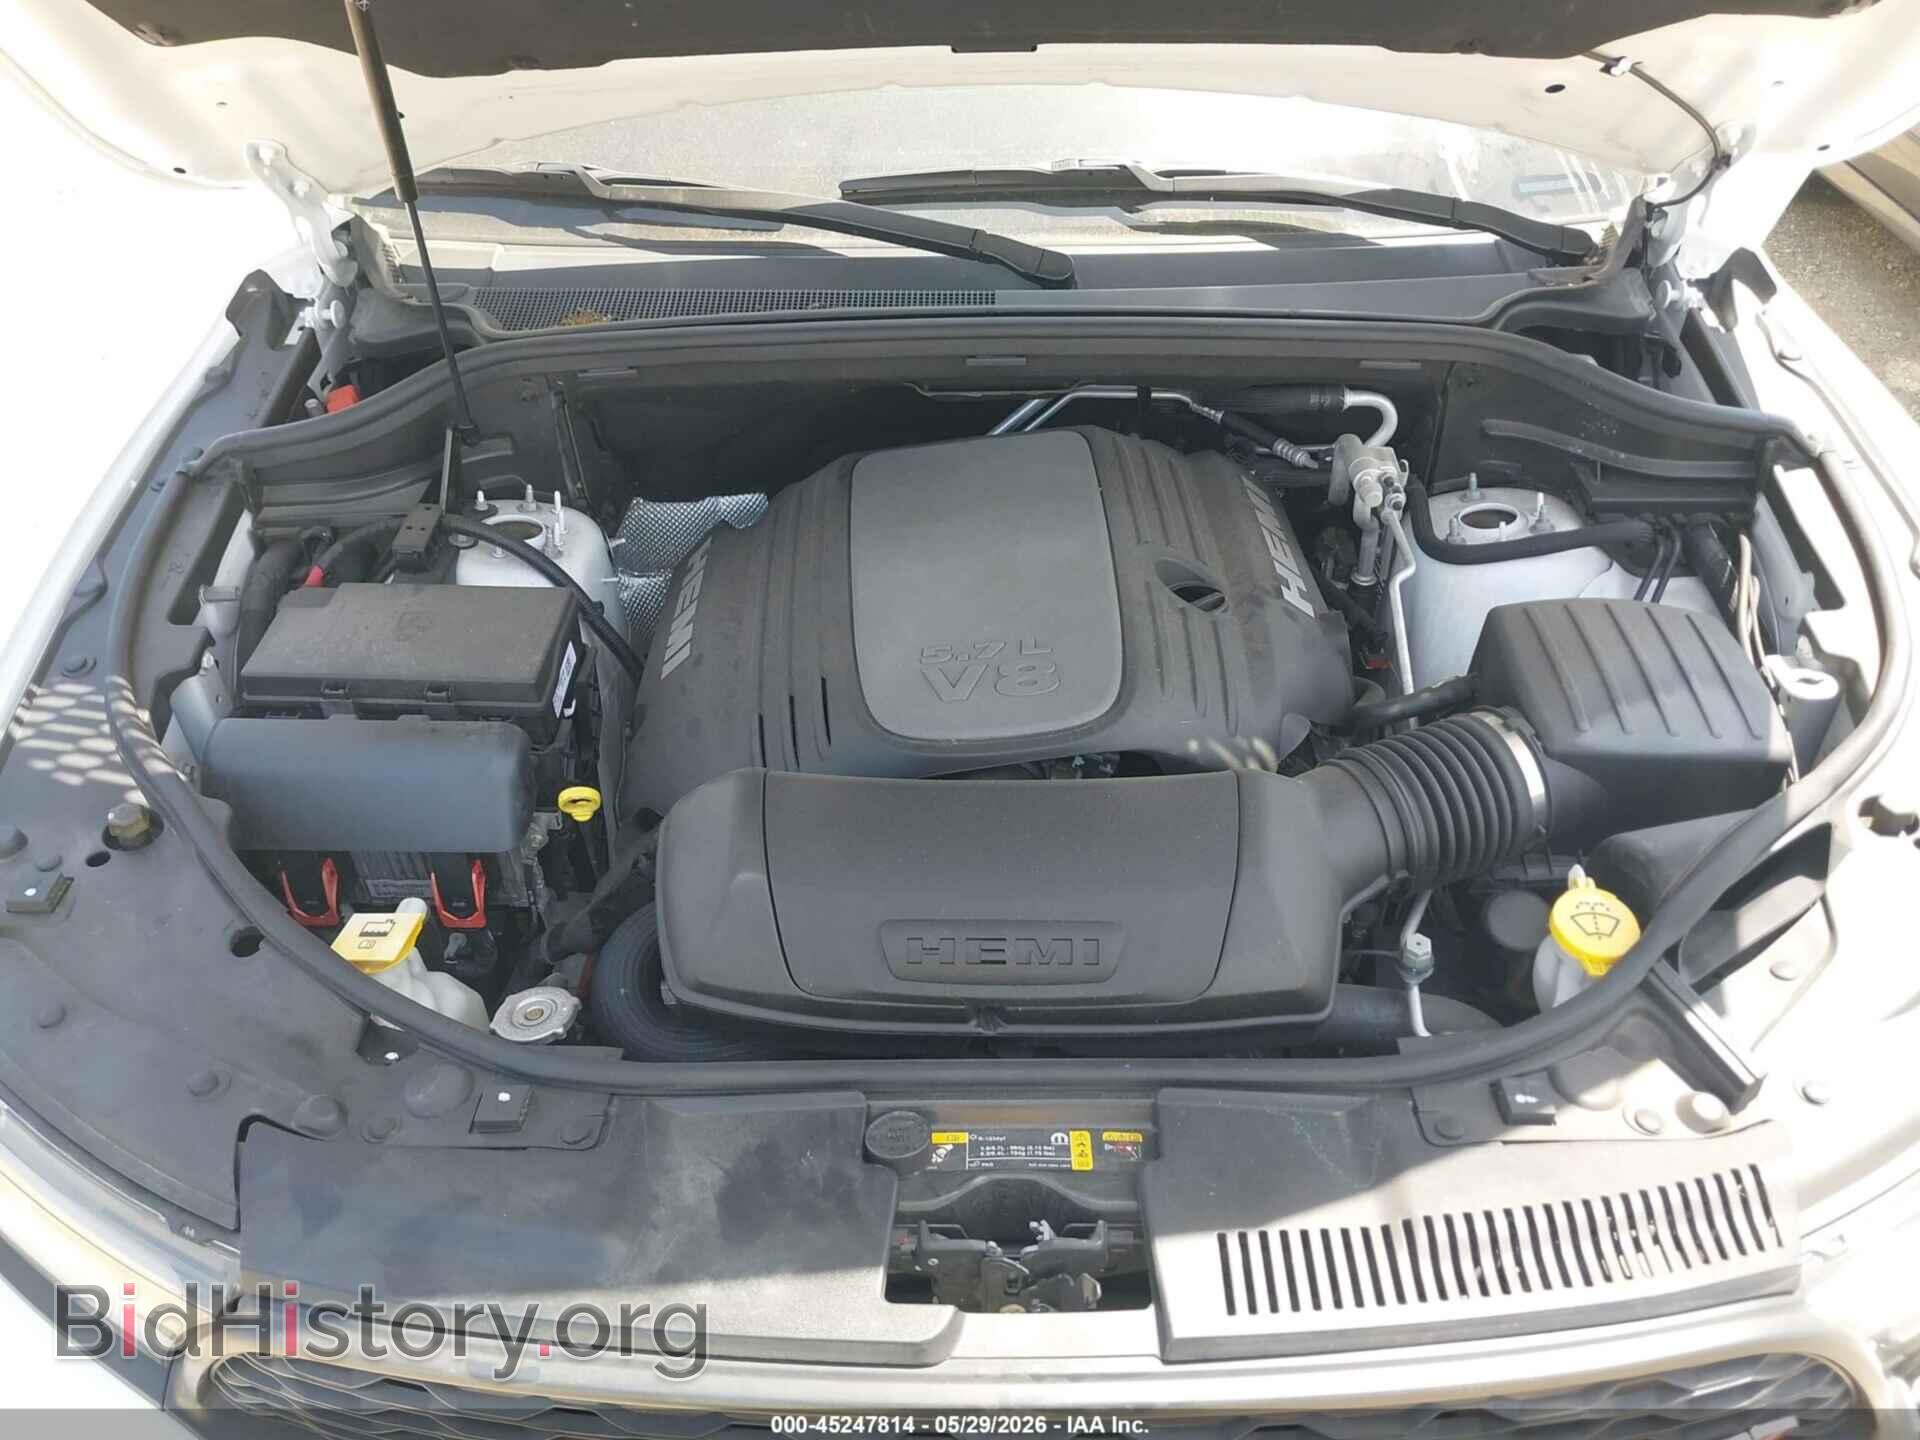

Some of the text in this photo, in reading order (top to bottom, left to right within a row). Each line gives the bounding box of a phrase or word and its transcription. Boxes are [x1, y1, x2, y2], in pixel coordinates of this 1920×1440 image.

[1240, 474, 1315, 618] HEMI
[660, 535, 713, 680] HEMI
[919, 662, 1062, 702] V8
[906, 937, 1100, 966] HEMI
